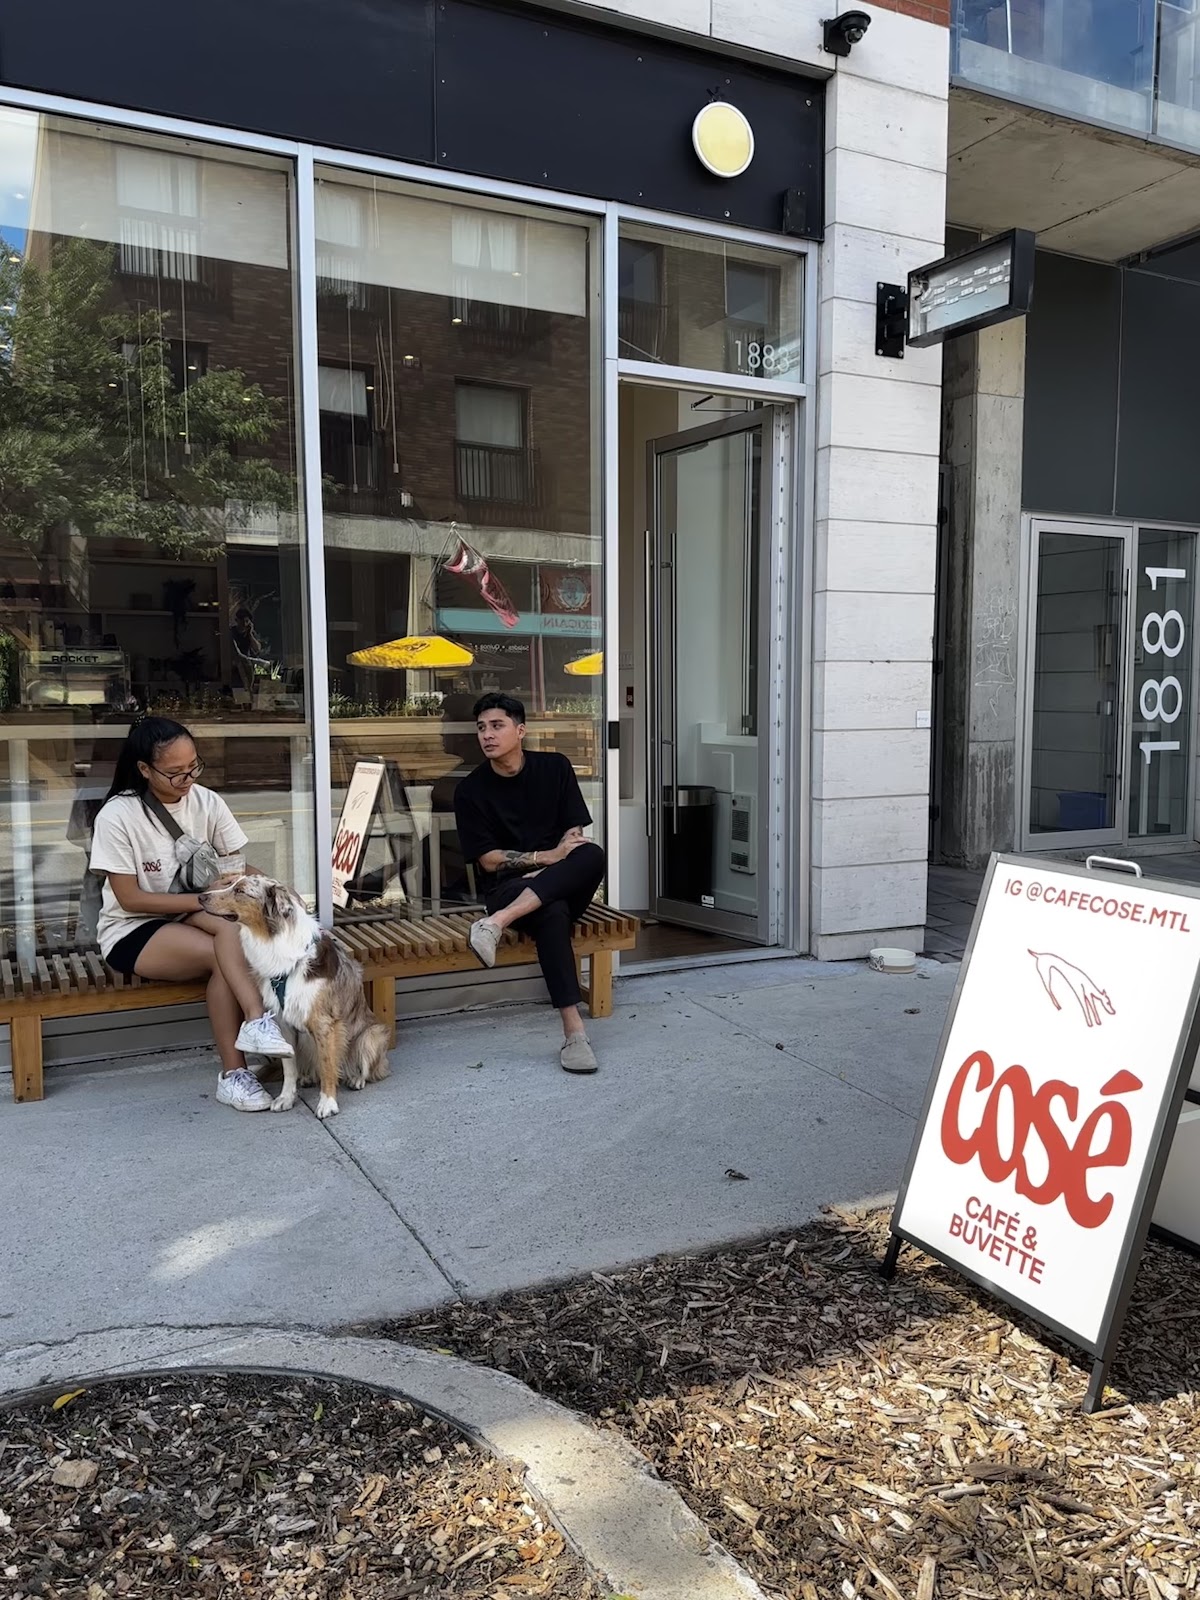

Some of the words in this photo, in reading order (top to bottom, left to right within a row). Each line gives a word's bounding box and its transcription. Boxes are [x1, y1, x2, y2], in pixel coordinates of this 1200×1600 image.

[735, 340, 790, 374] 1883
[51, 655, 99, 663] ROCKET
[1139, 567, 1186, 764] 1881
[1004, 879, 1022, 897] IG
[1026, 881, 1191, 933] @CAFECOSE.MTL
[949, 1214, 1046, 1285] BUVETTE
[965, 1195, 1021, 1241] CAFÉ
[1023, 1226, 1038, 1251] &
